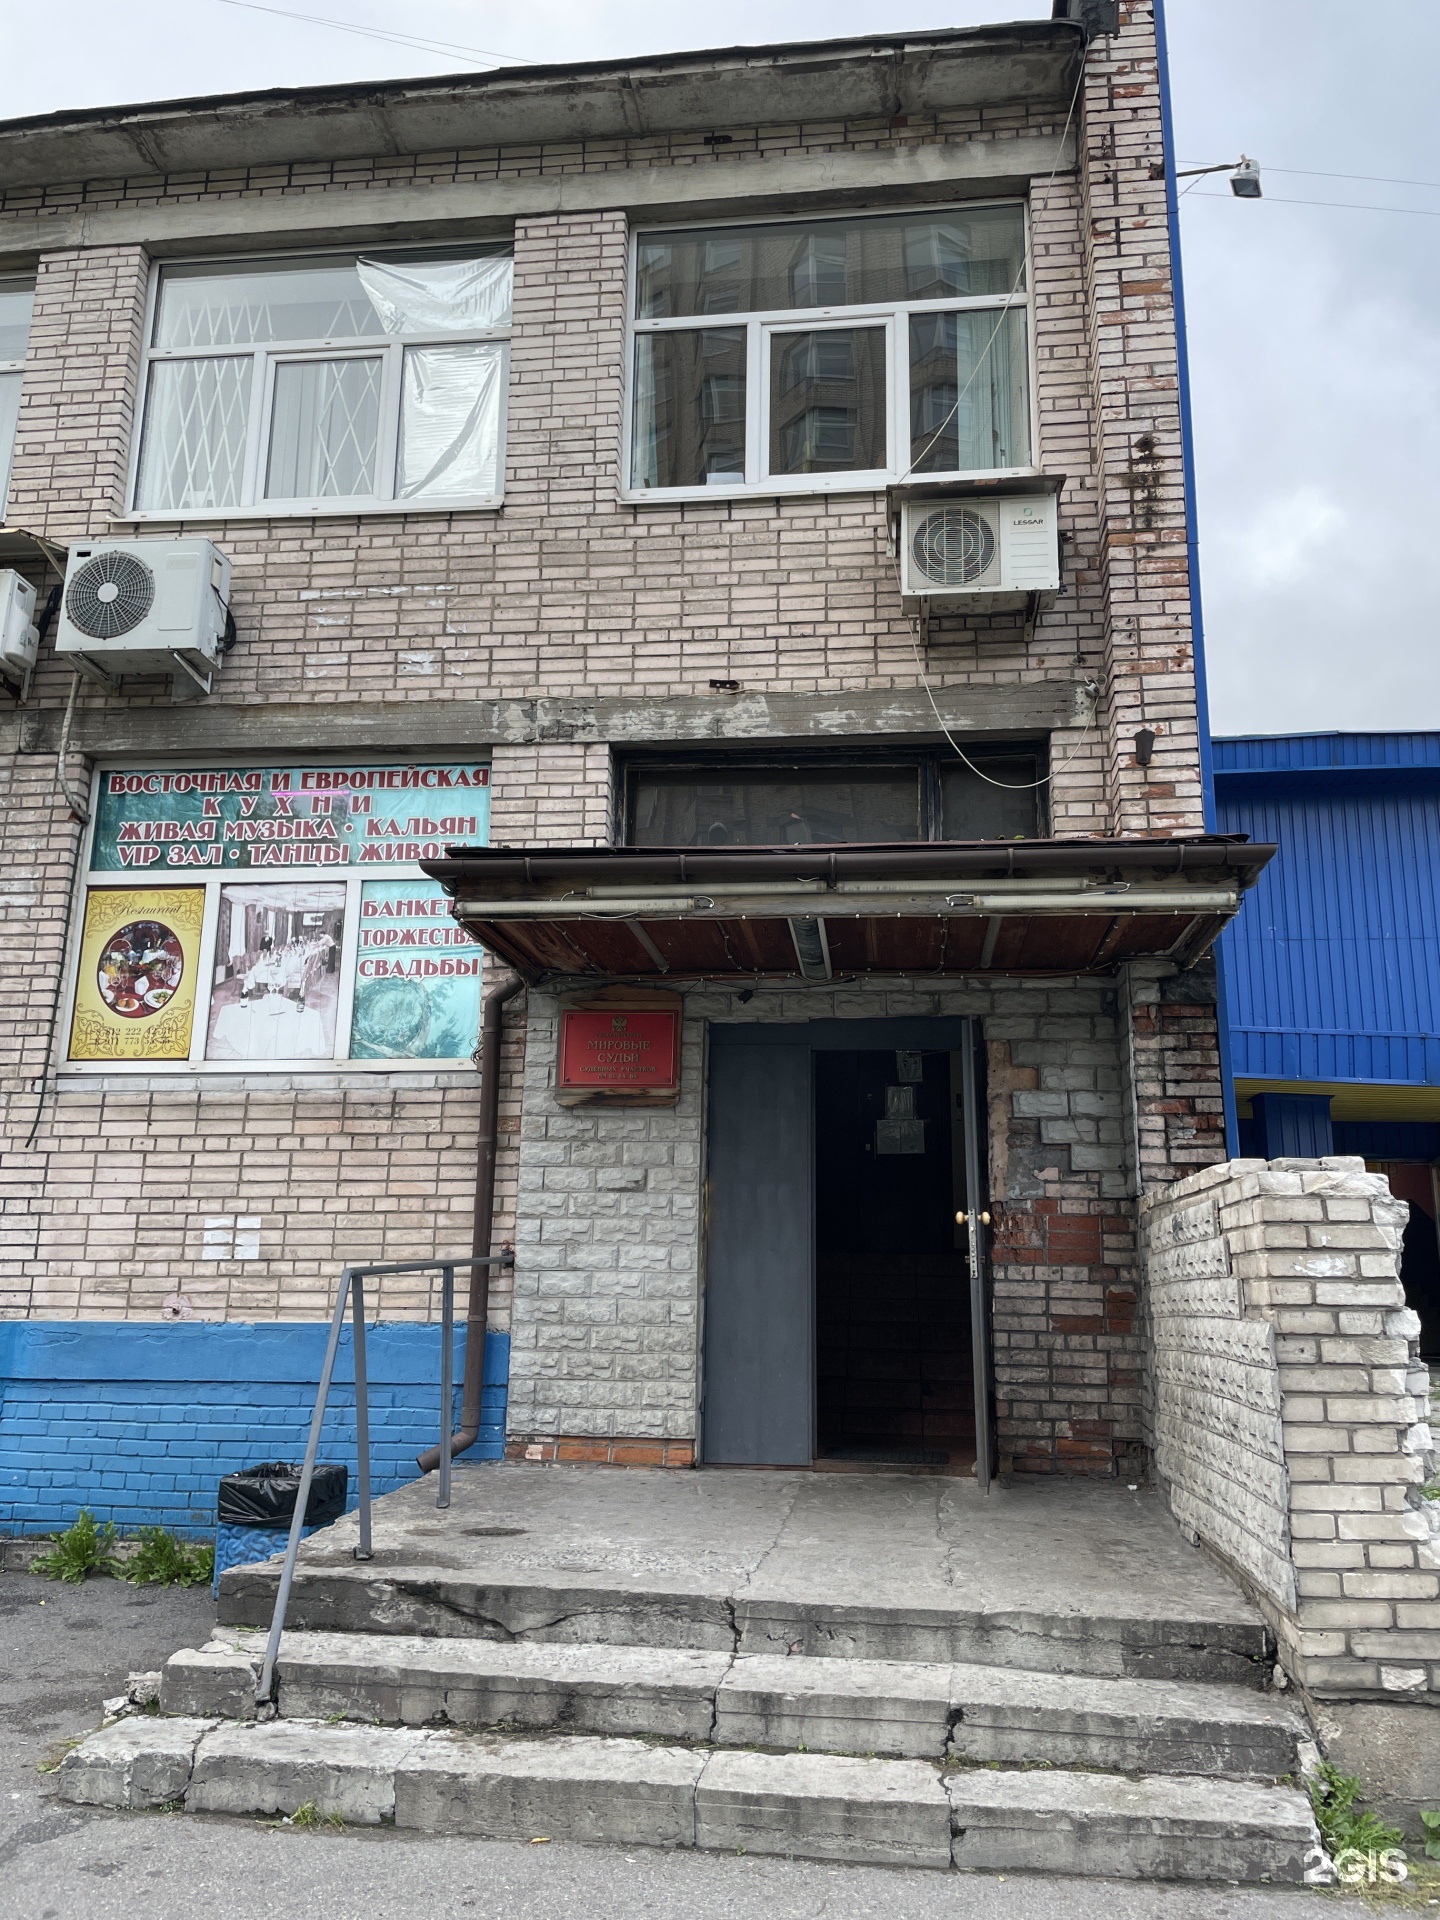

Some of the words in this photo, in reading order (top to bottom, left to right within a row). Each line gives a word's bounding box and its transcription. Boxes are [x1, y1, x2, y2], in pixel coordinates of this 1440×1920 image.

[108, 772, 262, 794] ВОСТОЧНАЯ
[270, 772, 291, 792] И
[300, 765, 491, 790] ЕВРОПЕЙСКАЯ
[117, 820, 216, 842] ЖИВАЯ
[223, 818, 338, 841] МУЗЫКА
[365, 816, 477, 837] КАЛЬЯН
[117, 845, 161, 865] VIP
[167, 844, 223, 865] ЗАЛ
[248, 842, 350, 867] ТАНЦЫ
[357, 841, 472, 863] ЖИВОТ
[113, 902, 182, 915] Restaurant
[358, 958, 480, 981] СВАДЬБЫ
[125, 1027, 141, 1035] 222
[124, 1037, 140, 1045] 773
[587, 1040, 651, 1050] МИРОВЫЕ
[597, 1053, 639, 1064] СУДЬИ
